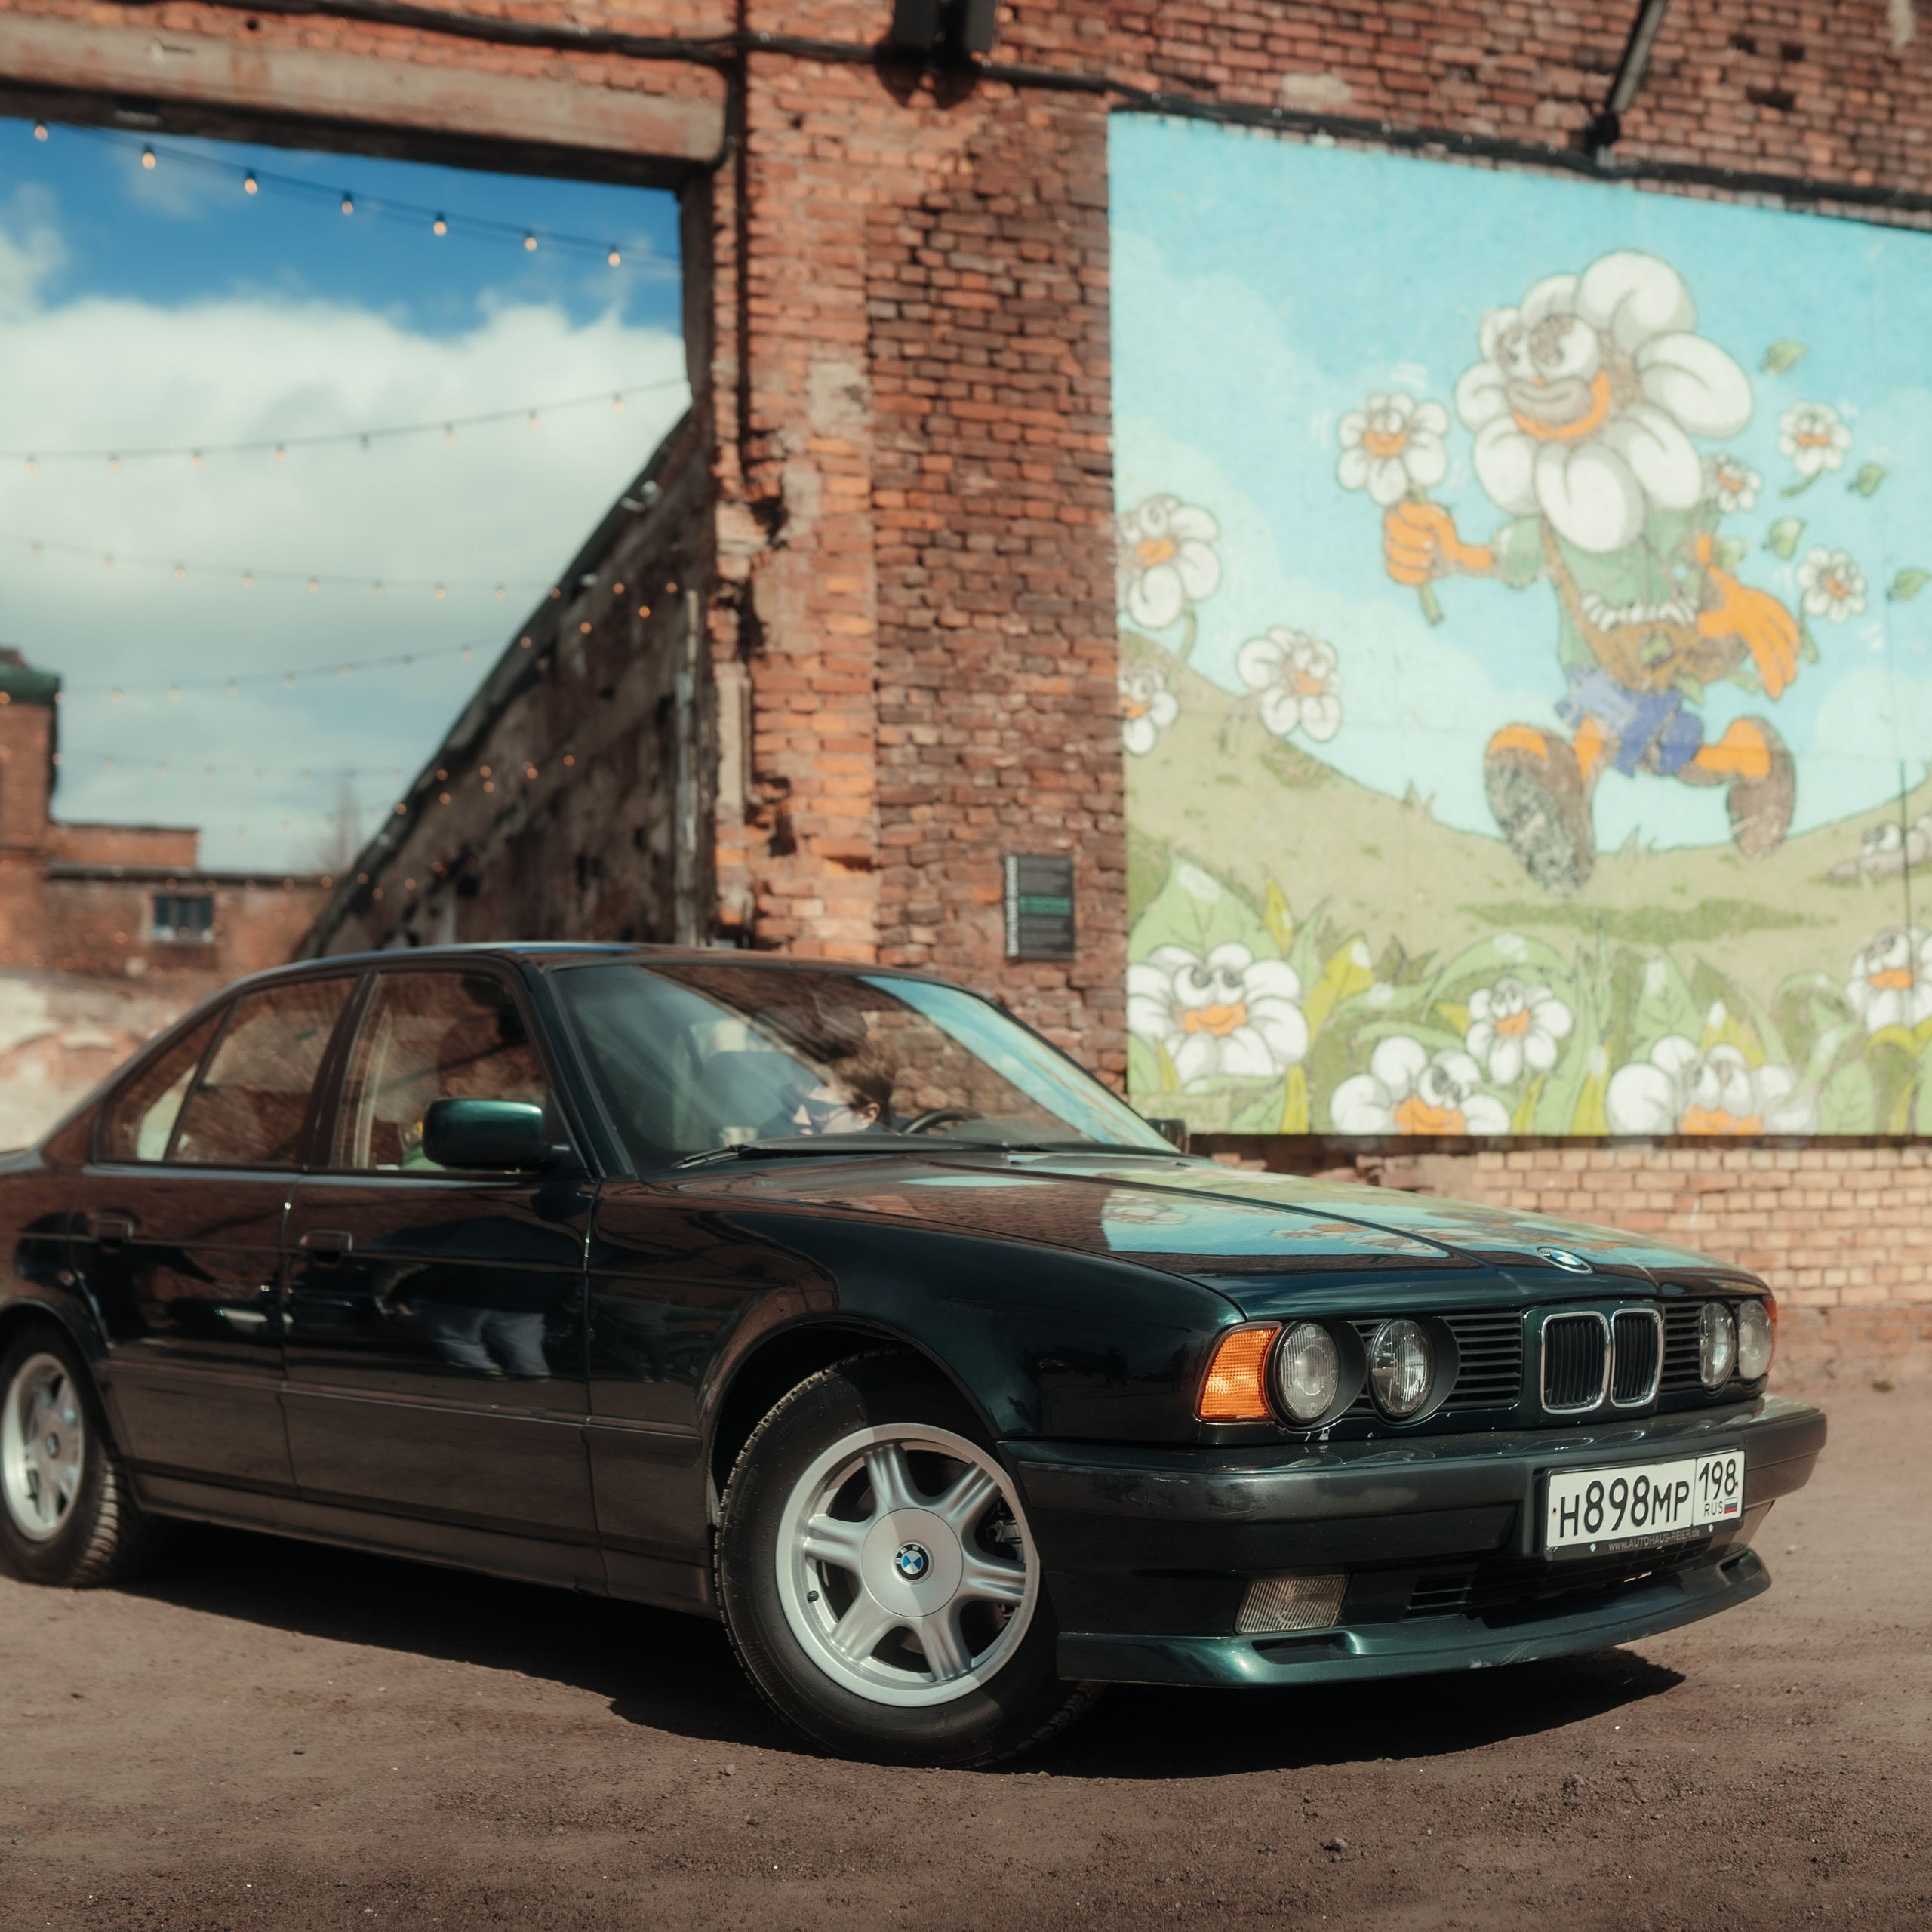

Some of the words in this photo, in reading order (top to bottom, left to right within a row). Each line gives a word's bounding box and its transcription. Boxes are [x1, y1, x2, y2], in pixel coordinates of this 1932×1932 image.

[1698, 1458, 1737, 1502] 198
[1703, 1500, 1724, 1517] RUS
[896, 1545, 919, 1564] BMW
